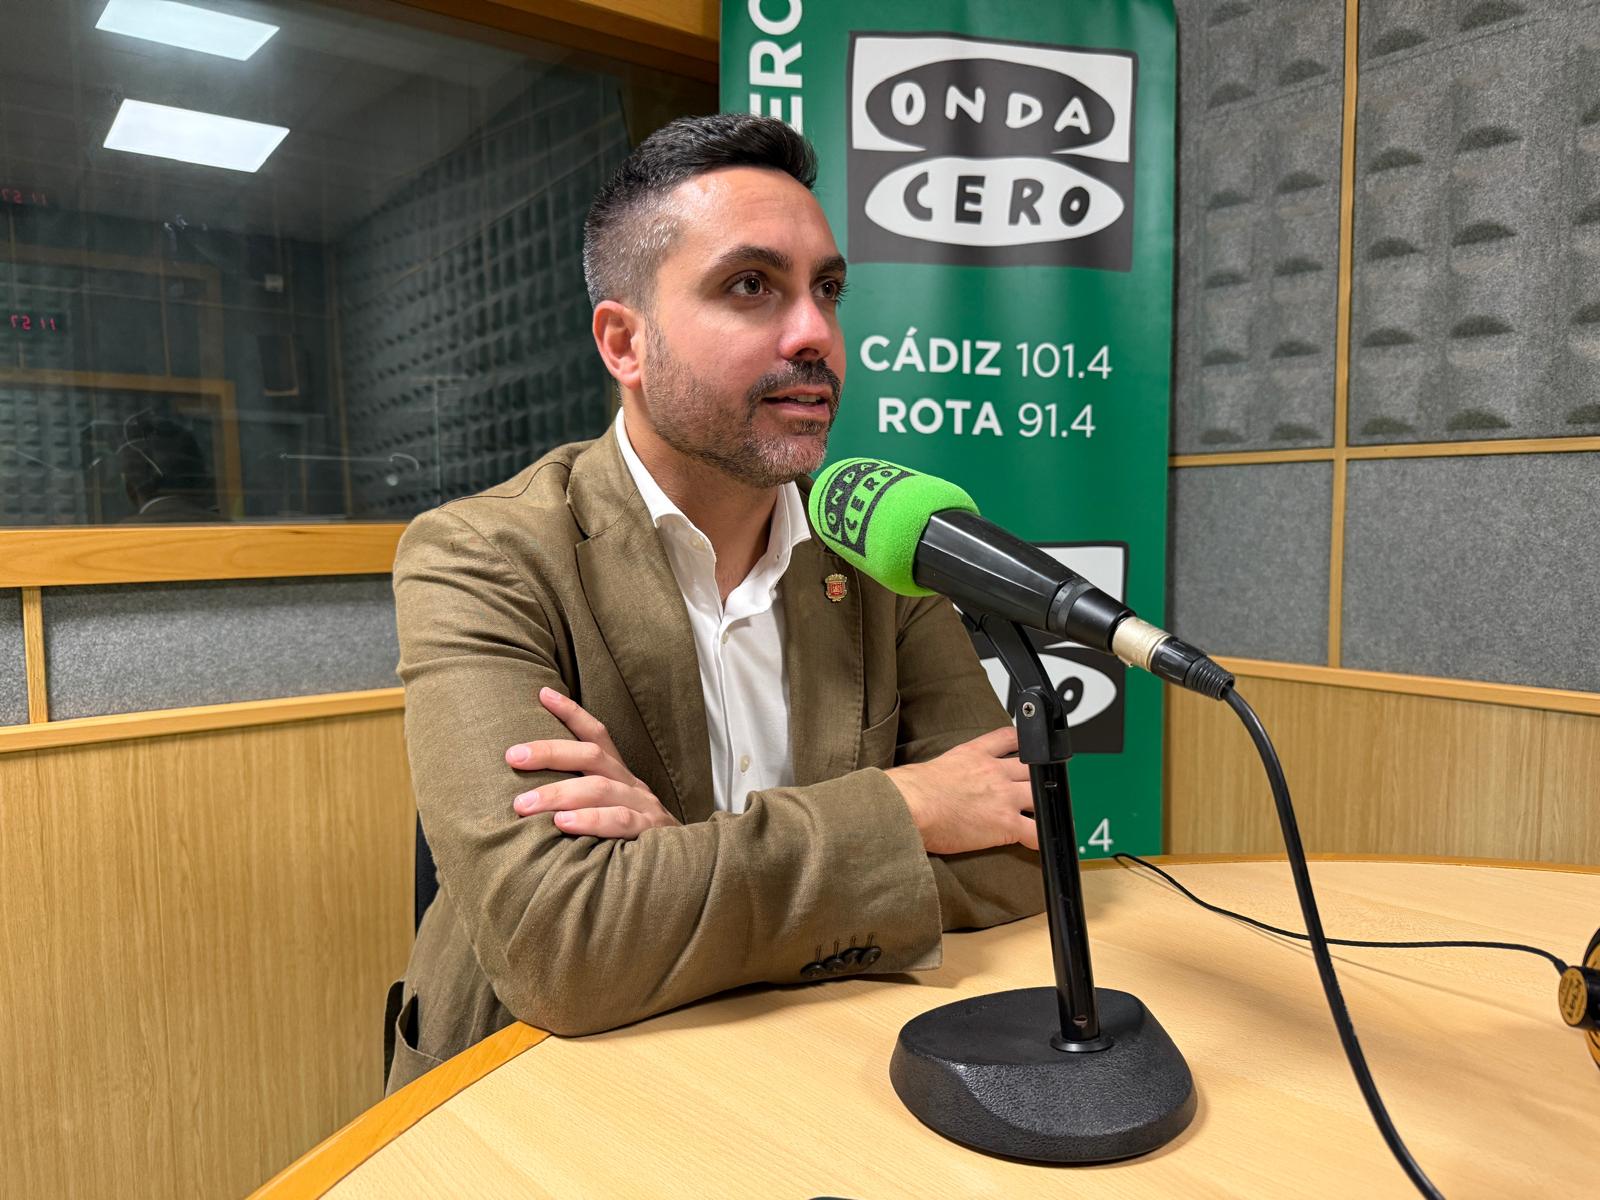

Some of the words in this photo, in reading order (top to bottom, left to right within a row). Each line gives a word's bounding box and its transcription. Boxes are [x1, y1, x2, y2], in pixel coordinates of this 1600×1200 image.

[748, 0, 803, 136] ERO
[890, 81, 1091, 135] ONDA
[904, 171, 1091, 227] CERO
[859, 326, 1001, 377] CÁDIZ
[1016, 341, 1113, 380] 101.4
[878, 397, 1004, 436] ROTA
[1018, 402, 1097, 438] 91.4
[827, 463, 872, 525] ONDA
[845, 469, 893, 531] CERO
